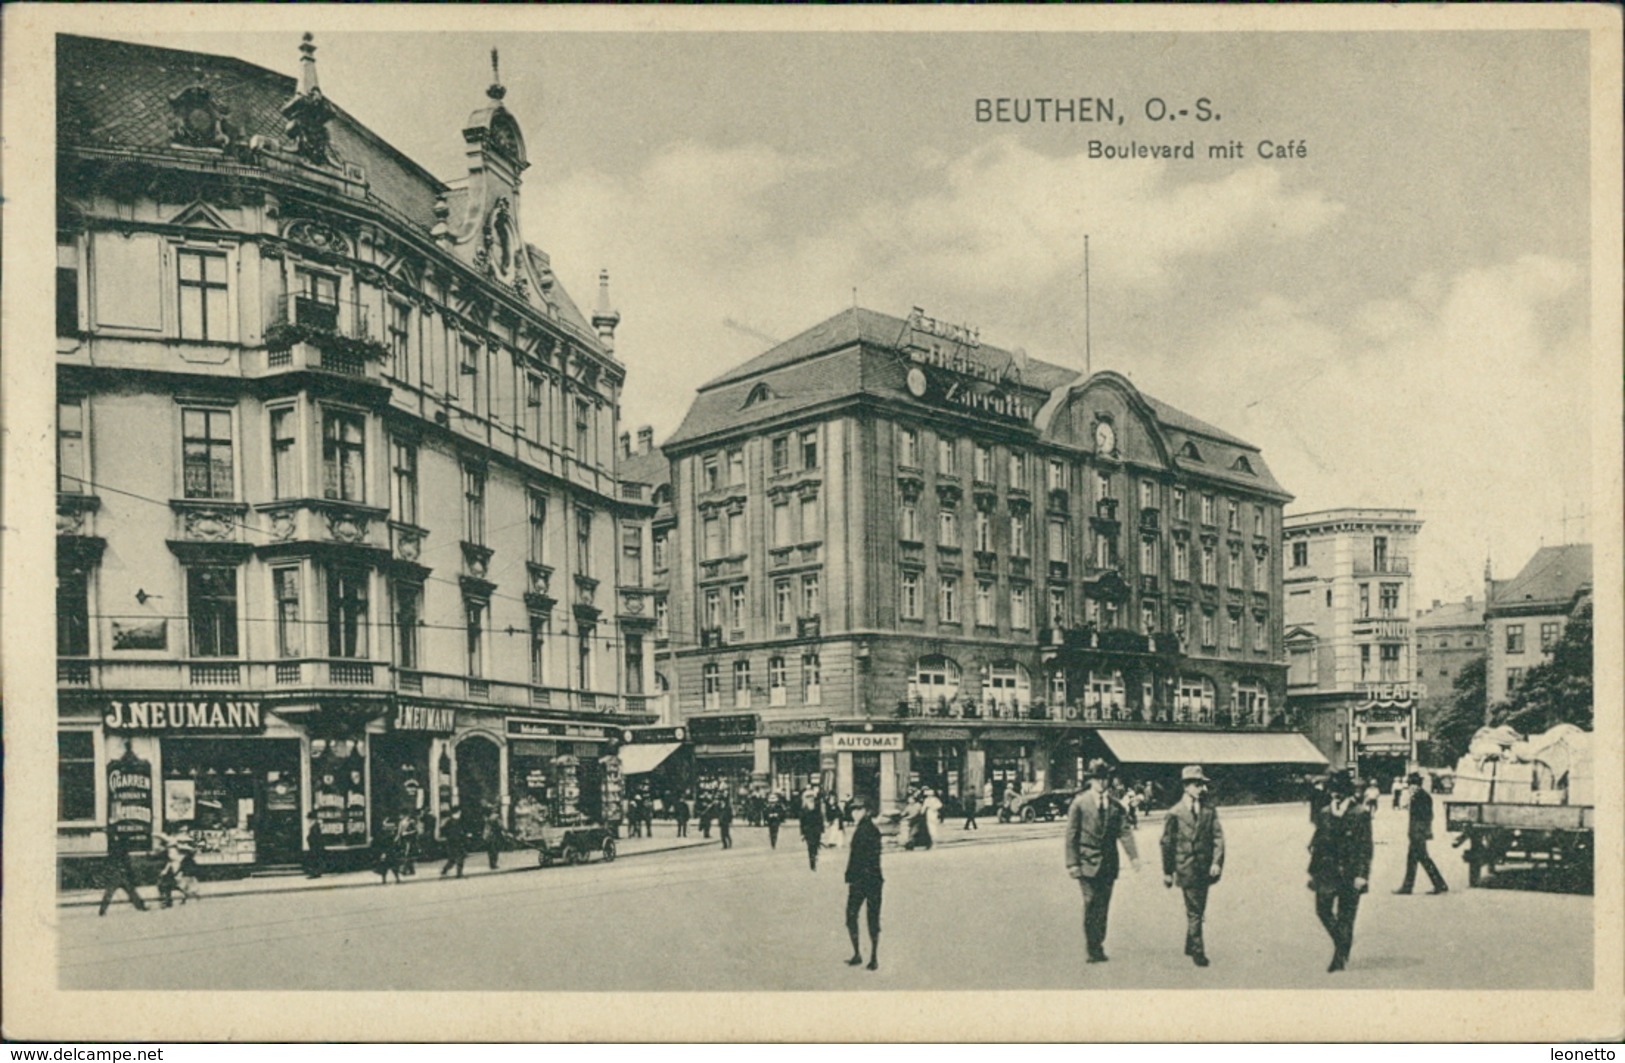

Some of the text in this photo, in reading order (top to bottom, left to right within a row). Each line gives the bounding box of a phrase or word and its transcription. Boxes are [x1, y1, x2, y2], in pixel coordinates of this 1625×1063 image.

[1367, 684, 1428, 700] THEATER
[105, 701, 260, 728] J.NEUMANN
[837, 737, 898, 747] AUTOMAT
